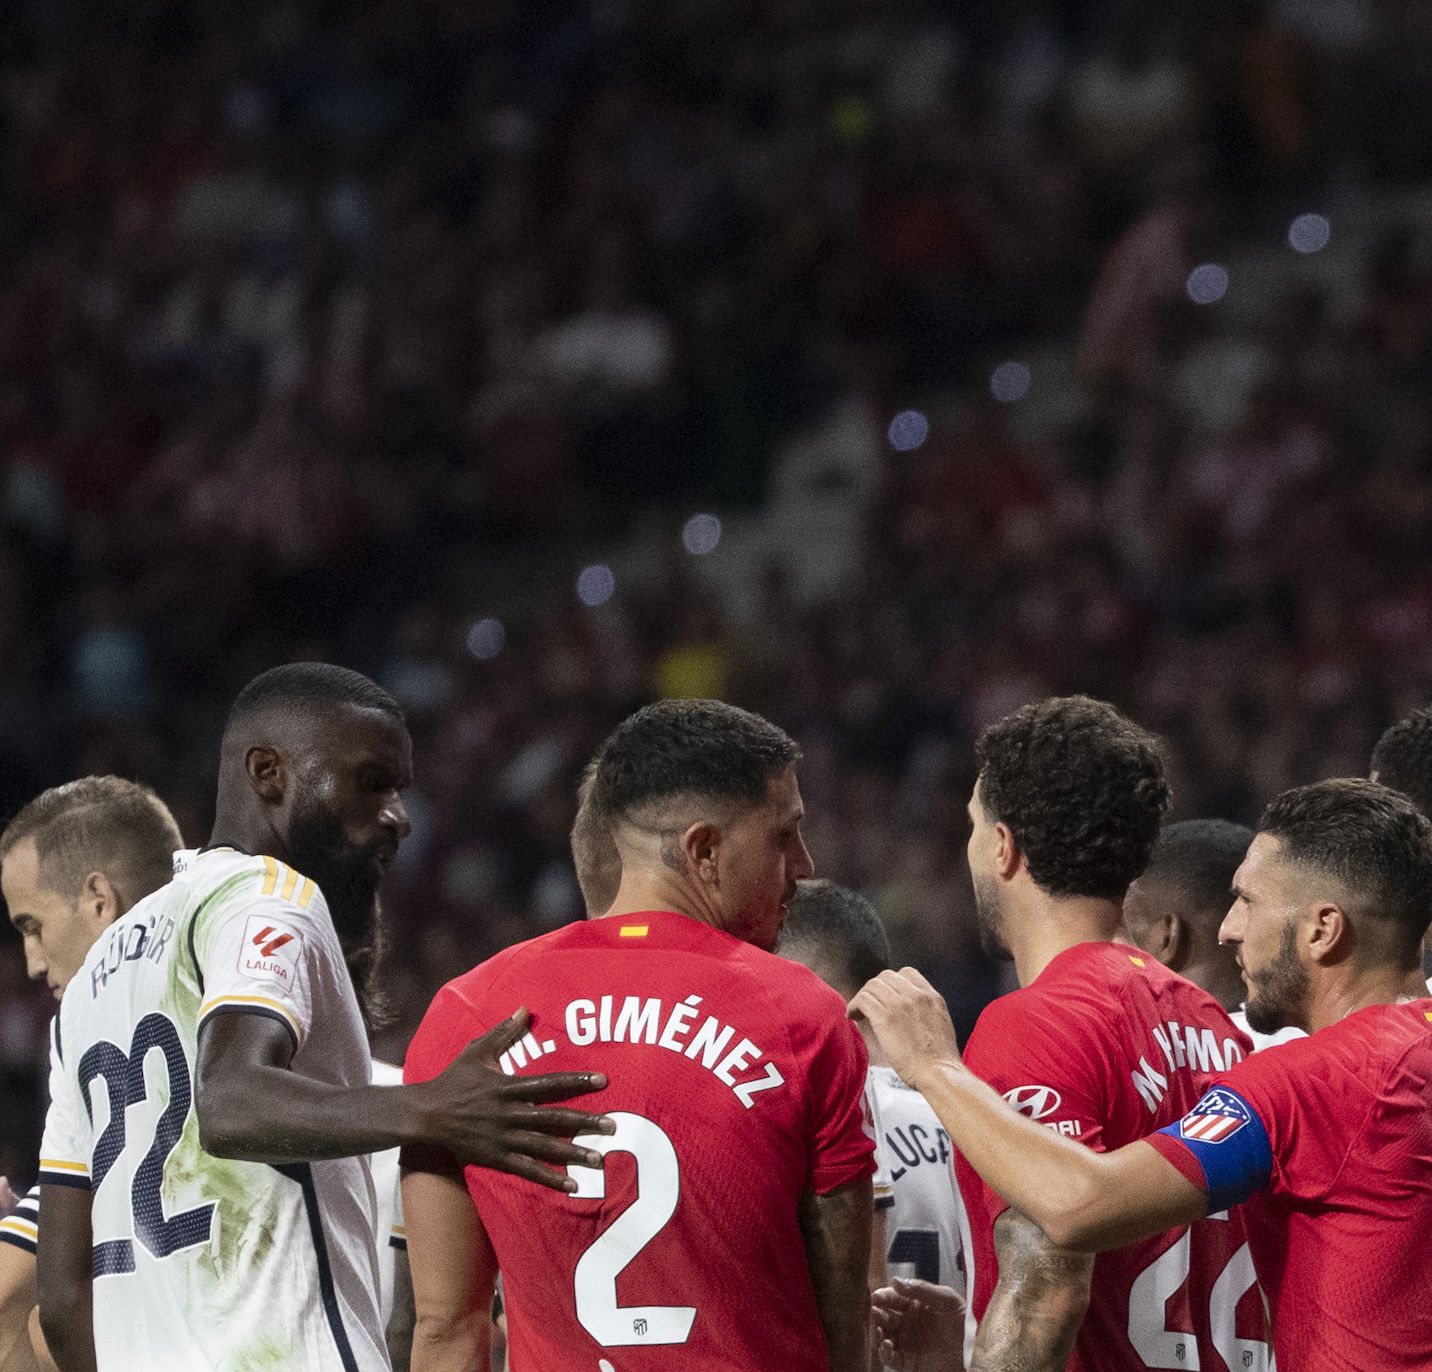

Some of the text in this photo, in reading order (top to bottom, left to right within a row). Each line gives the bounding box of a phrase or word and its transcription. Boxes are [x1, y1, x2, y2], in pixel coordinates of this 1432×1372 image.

[246, 959, 288, 980] LALIGA
[500, 995, 785, 1109] M. GIMÉNEZ
[77, 1012, 220, 1280] 22
[567, 1111, 698, 1348] 2
